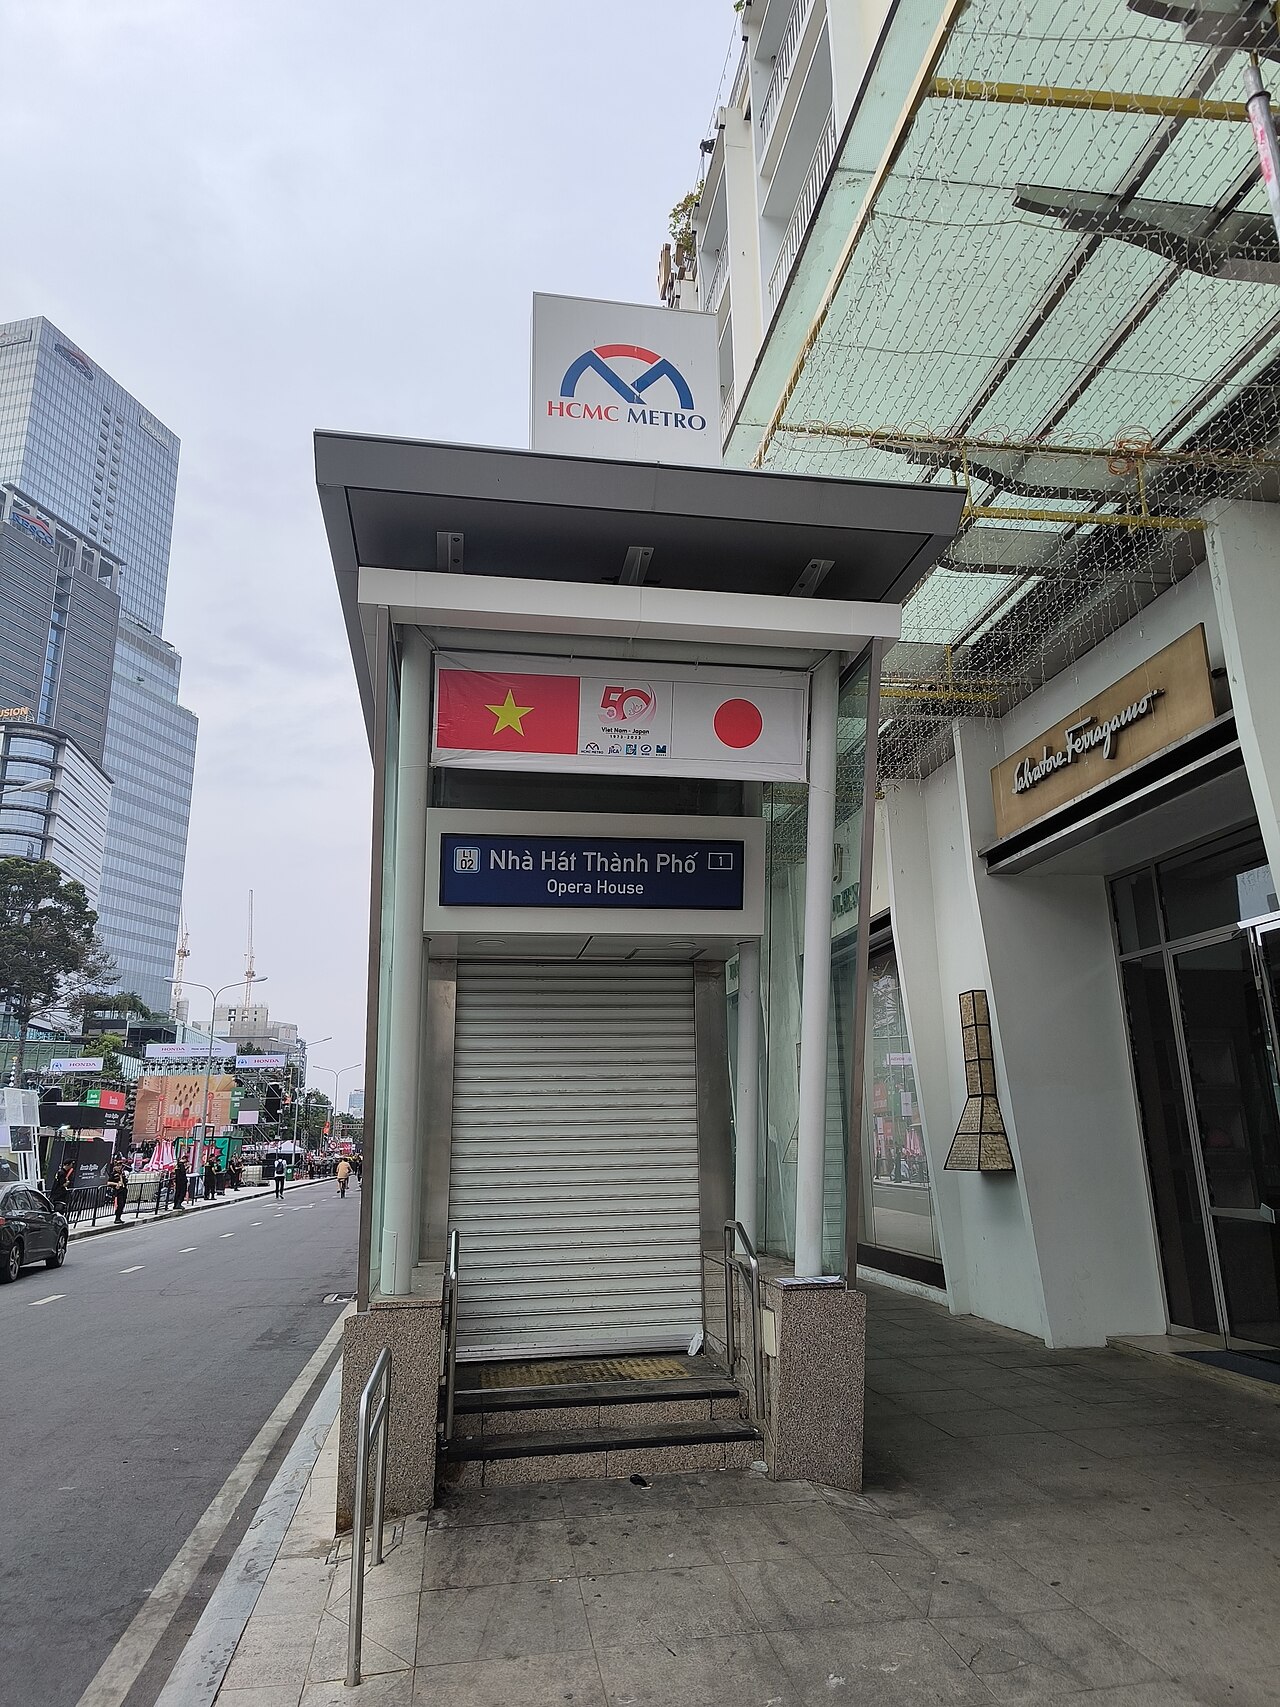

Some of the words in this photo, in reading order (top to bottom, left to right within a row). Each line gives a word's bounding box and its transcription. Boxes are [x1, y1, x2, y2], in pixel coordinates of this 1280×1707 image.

[547, 400, 619, 422] HCMC
[627, 408, 707, 431] METRO
[1012, 745, 1067, 794] Salvatore
[1065, 688, 1165, 763] Ferragamo
[462, 850, 472, 858] L1
[490, 849, 533, 870] Nhà
[541, 851, 577, 871] Hát
[583, 851, 649, 873] Thành
[656, 851, 699, 873] Phố
[718, 856, 723, 867] 1
[460, 859, 474, 870] 02
[547, 879, 592, 896] Opera
[597, 880, 644, 894] House
